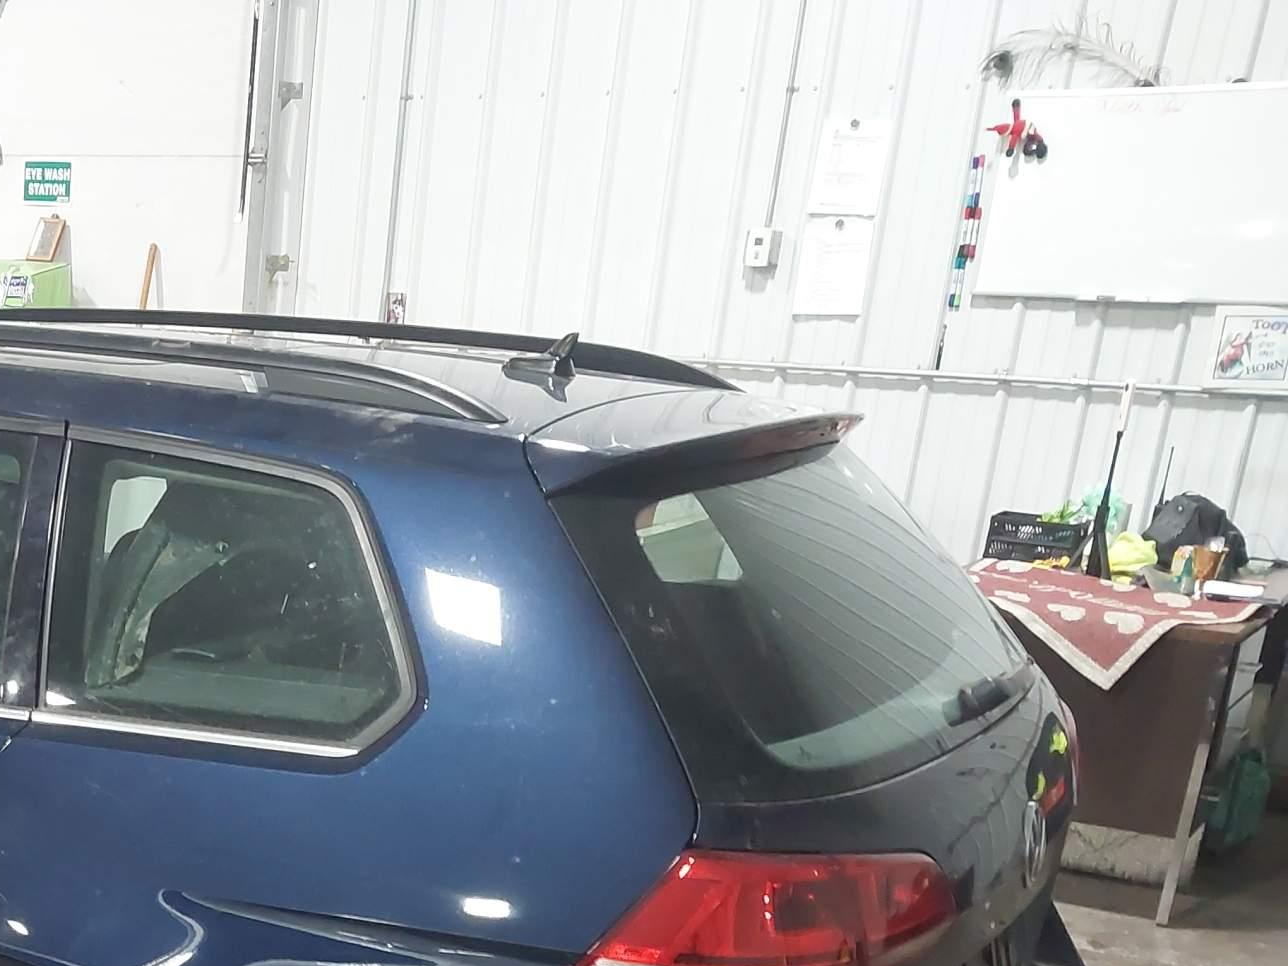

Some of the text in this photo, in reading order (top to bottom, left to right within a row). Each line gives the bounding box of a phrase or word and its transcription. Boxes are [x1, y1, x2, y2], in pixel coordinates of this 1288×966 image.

[25, 167, 71, 181] EYE WASH
[28, 183, 66, 196] STATION
